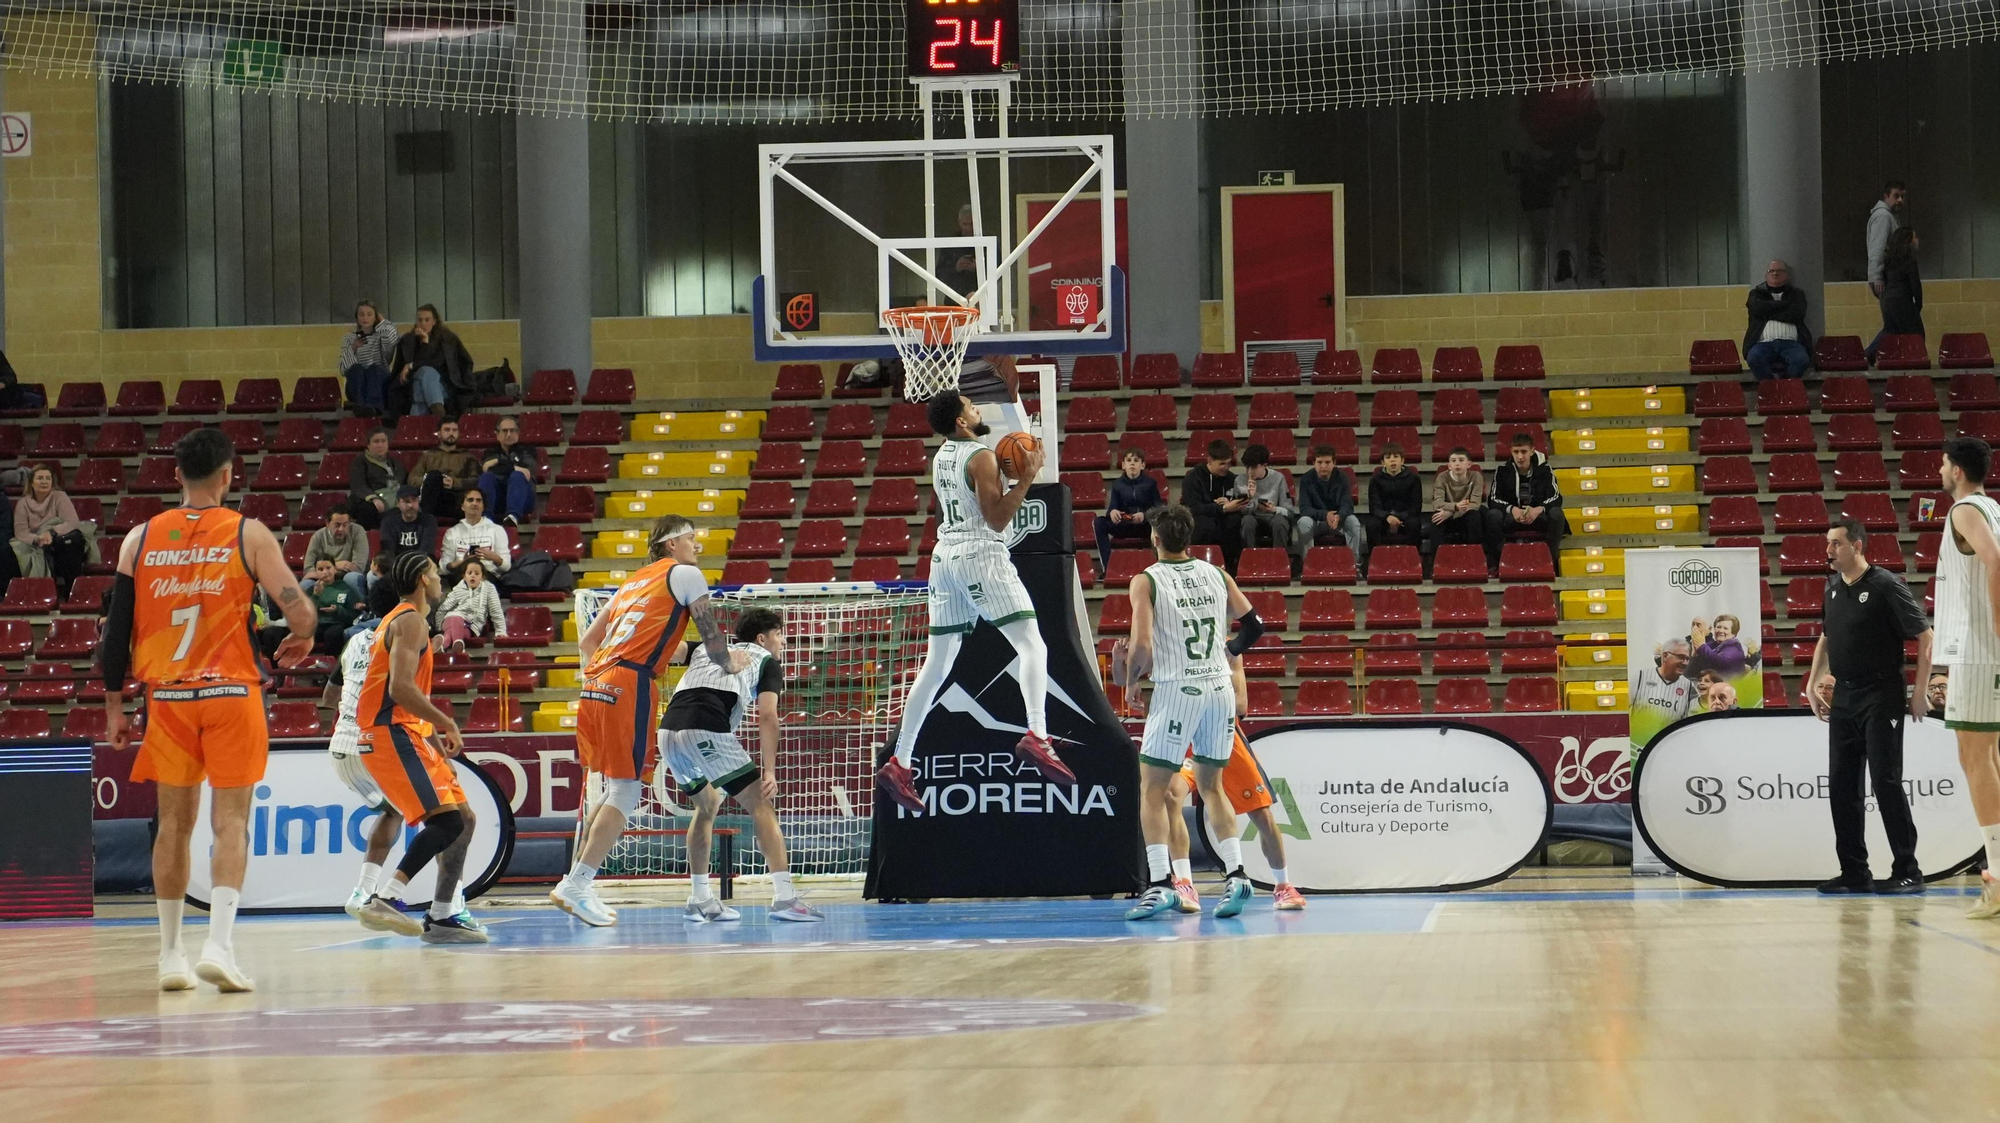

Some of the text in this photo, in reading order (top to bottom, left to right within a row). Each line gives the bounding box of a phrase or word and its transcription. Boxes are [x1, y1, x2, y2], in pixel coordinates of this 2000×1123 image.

[930, 19, 1000, 68] 24
[143, 544, 233, 567] GONZÁLEZ
[170, 603, 201, 662] 7
[1183, 616, 1216, 660] 27
[1648, 697, 1672, 709] coto
[910, 752, 1041, 781] SIERRA
[1319, 775, 1509, 795] Junta de Andalucía
[1320, 799, 1492, 817] Consejería de Turismo,
[1321, 820, 1449, 835] Cultura y Deporte
